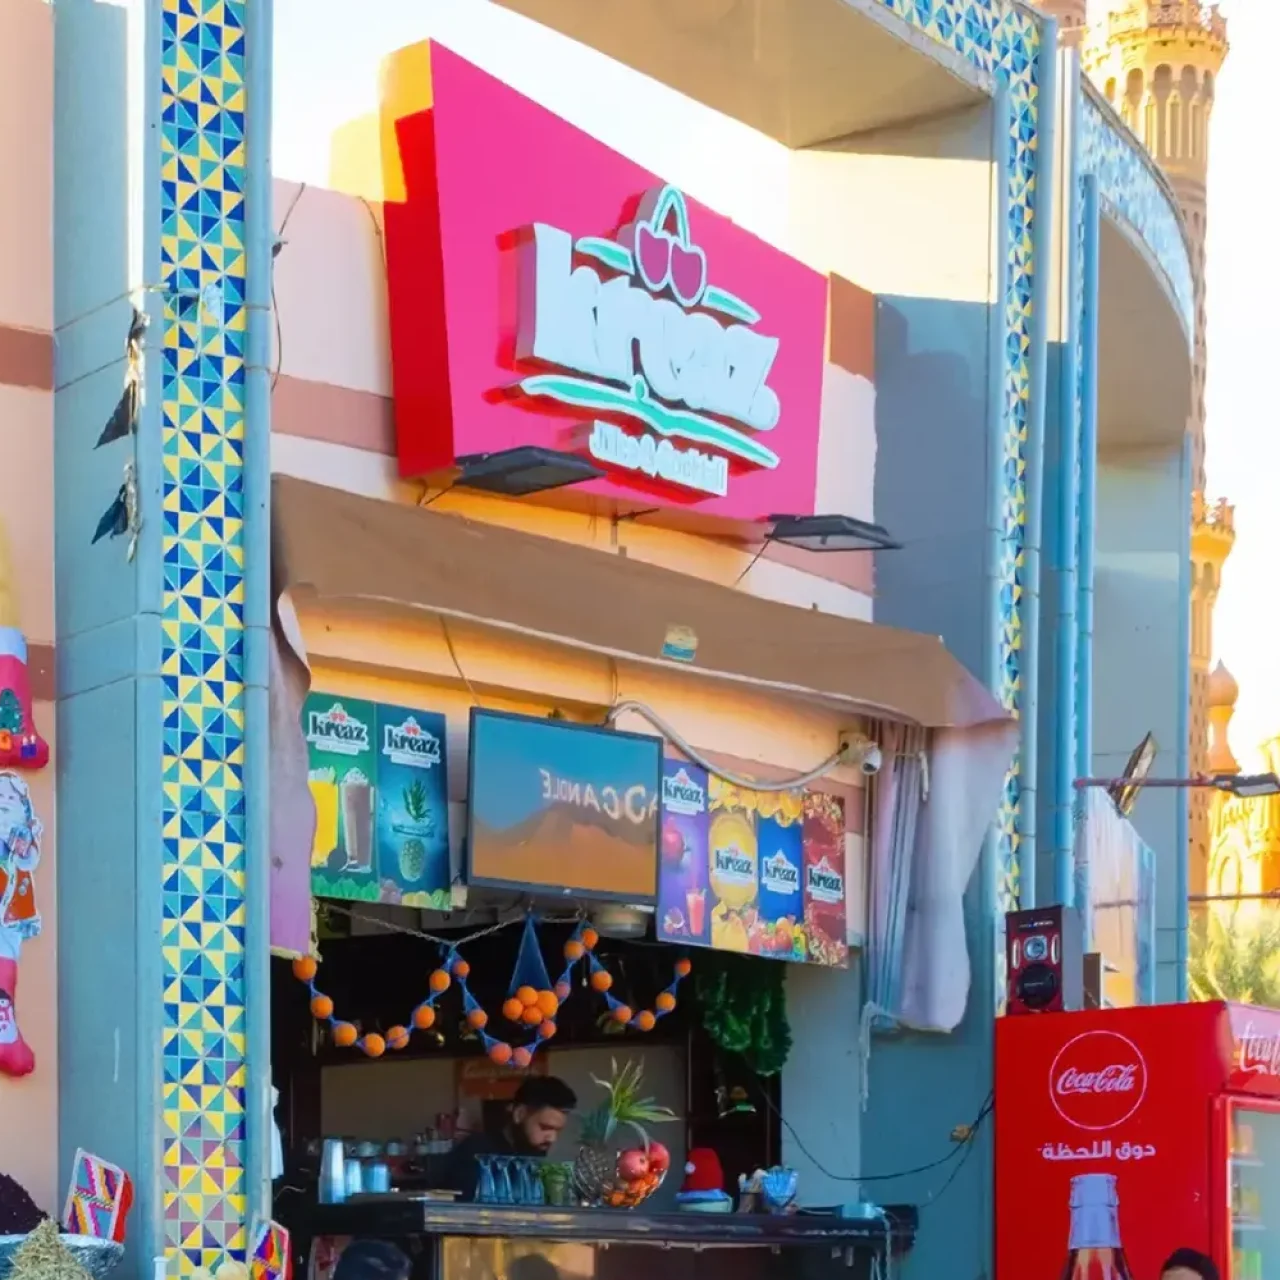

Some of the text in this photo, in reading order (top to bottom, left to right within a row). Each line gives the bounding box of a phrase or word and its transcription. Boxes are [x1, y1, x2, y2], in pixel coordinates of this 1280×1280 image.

[310, 714, 366, 743] kreaz
[387, 728, 440, 755] kreaz
[663, 778, 702, 804] kreaz
[714, 850, 753, 875] kreaz
[763, 860, 797, 883] kreaz
[809, 867, 842, 891] kreaz
[1056, 1064, 1139, 1095] Coca-Cola
[1041, 1139, 1112, 1161] اللحظة
